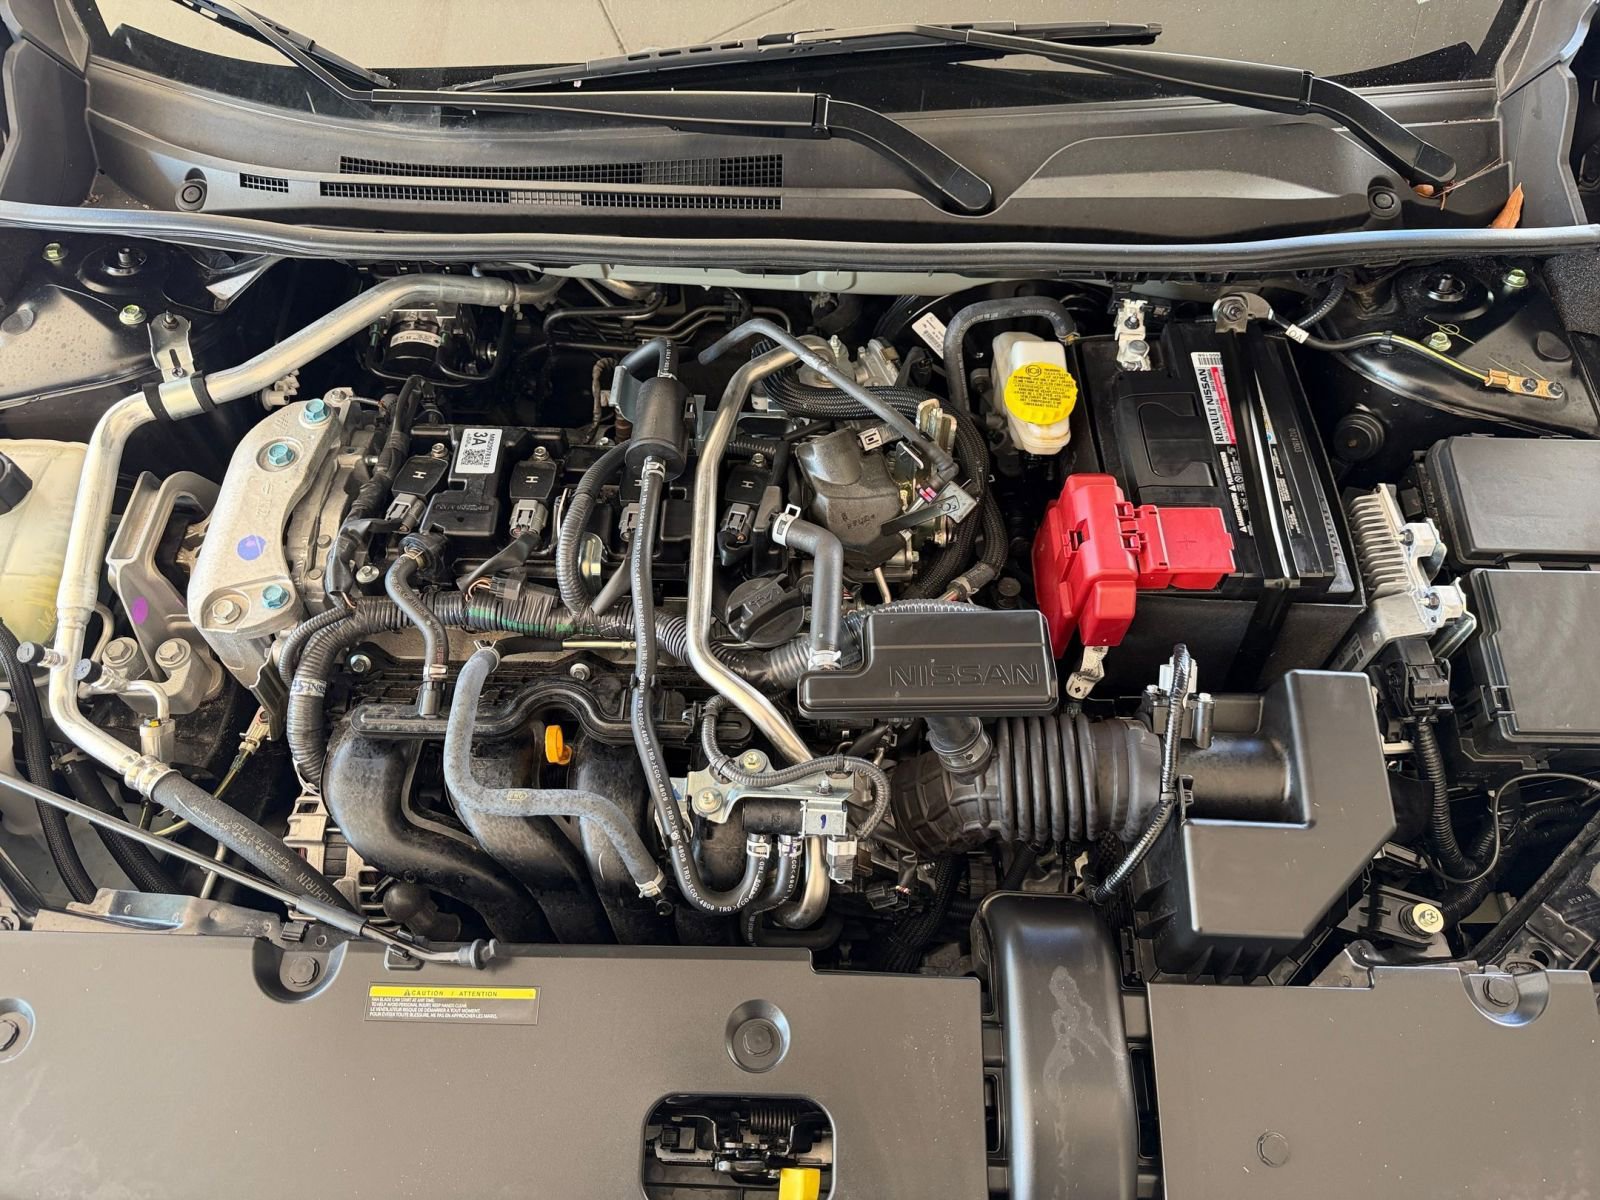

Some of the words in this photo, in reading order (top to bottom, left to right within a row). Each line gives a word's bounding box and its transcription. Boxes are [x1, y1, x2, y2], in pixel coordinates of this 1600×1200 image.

[1198, 368, 1214, 406] NISSAN
[471, 432, 488, 446] 3A
[1209, 408, 1225, 442] RENAULT
[889, 663, 1040, 688] NISSAN
